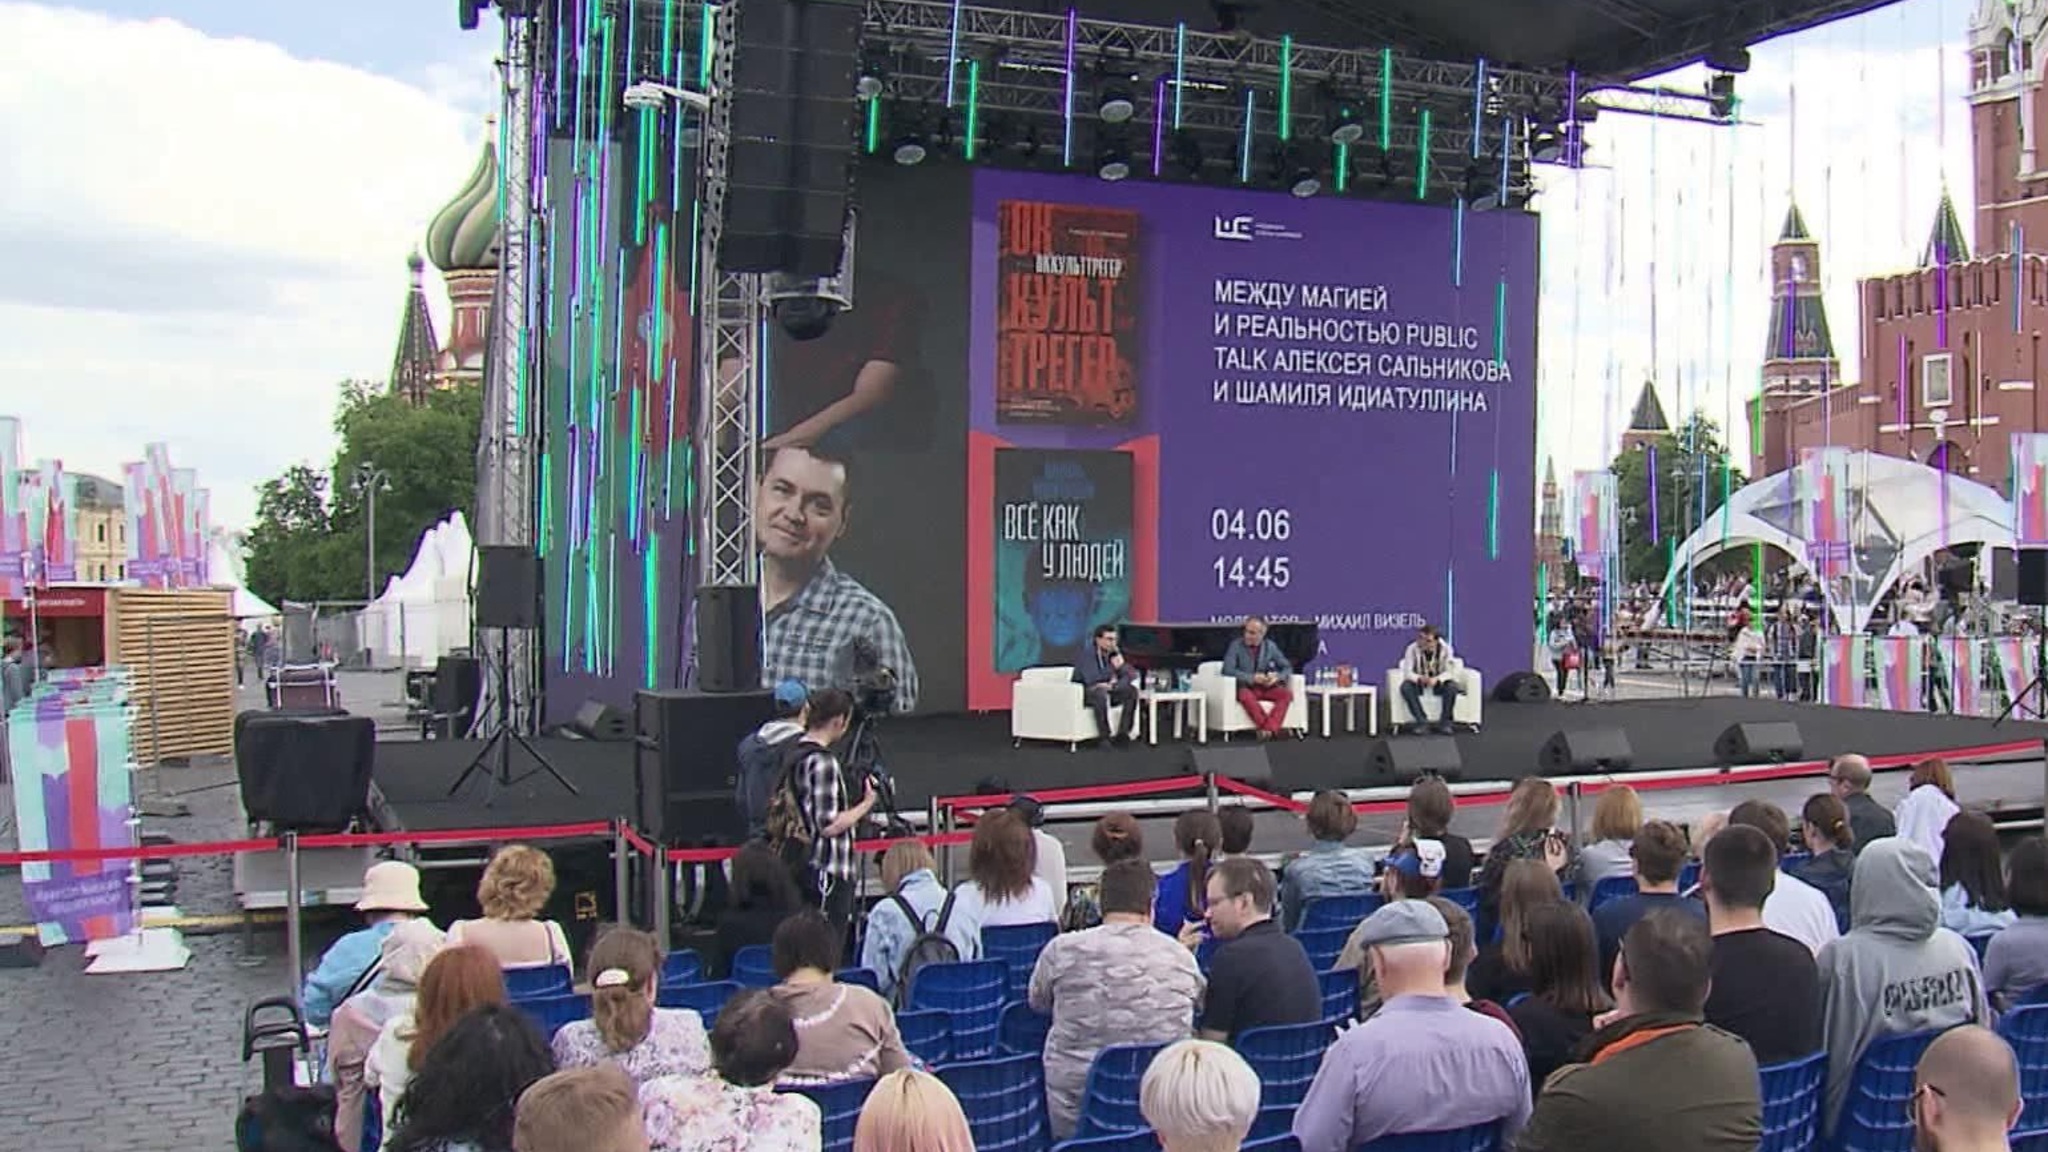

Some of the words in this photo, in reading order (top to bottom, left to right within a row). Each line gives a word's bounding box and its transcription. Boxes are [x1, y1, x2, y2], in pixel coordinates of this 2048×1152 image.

[1214, 279, 1295, 310] МЕЖДУ
[1301, 284, 1388, 312] МАГИЕЙ
[1214, 312, 1229, 337] И
[1236, 314, 1401, 345] РЕАЛЬНОСТЬЮ
[1406, 323, 1478, 350] PUBLIC
[1213, 346, 1268, 371] TALK
[1272, 348, 1371, 375] АЛЕКСЕЯ
[1378, 354, 1512, 382] САЛЬНИКОВА
[1213, 379, 1228, 402] И
[1235, 379, 1331, 406] ШАМИЛЯ
[1338, 384, 1488, 412] ИДИАТУЛЛИНА
[1042, 503, 1080, 541] КАК
[1211, 508, 1290, 540] 04.06
[1042, 541, 1054, 578] У
[1058, 538, 1124, 583] ЛЮДЕЙ
[1213, 556, 1290, 589] 14:45
[1315, 613, 1371, 630] МИХАИЛ
[1374, 612, 1427, 629] ВИЗЕЛЬ
